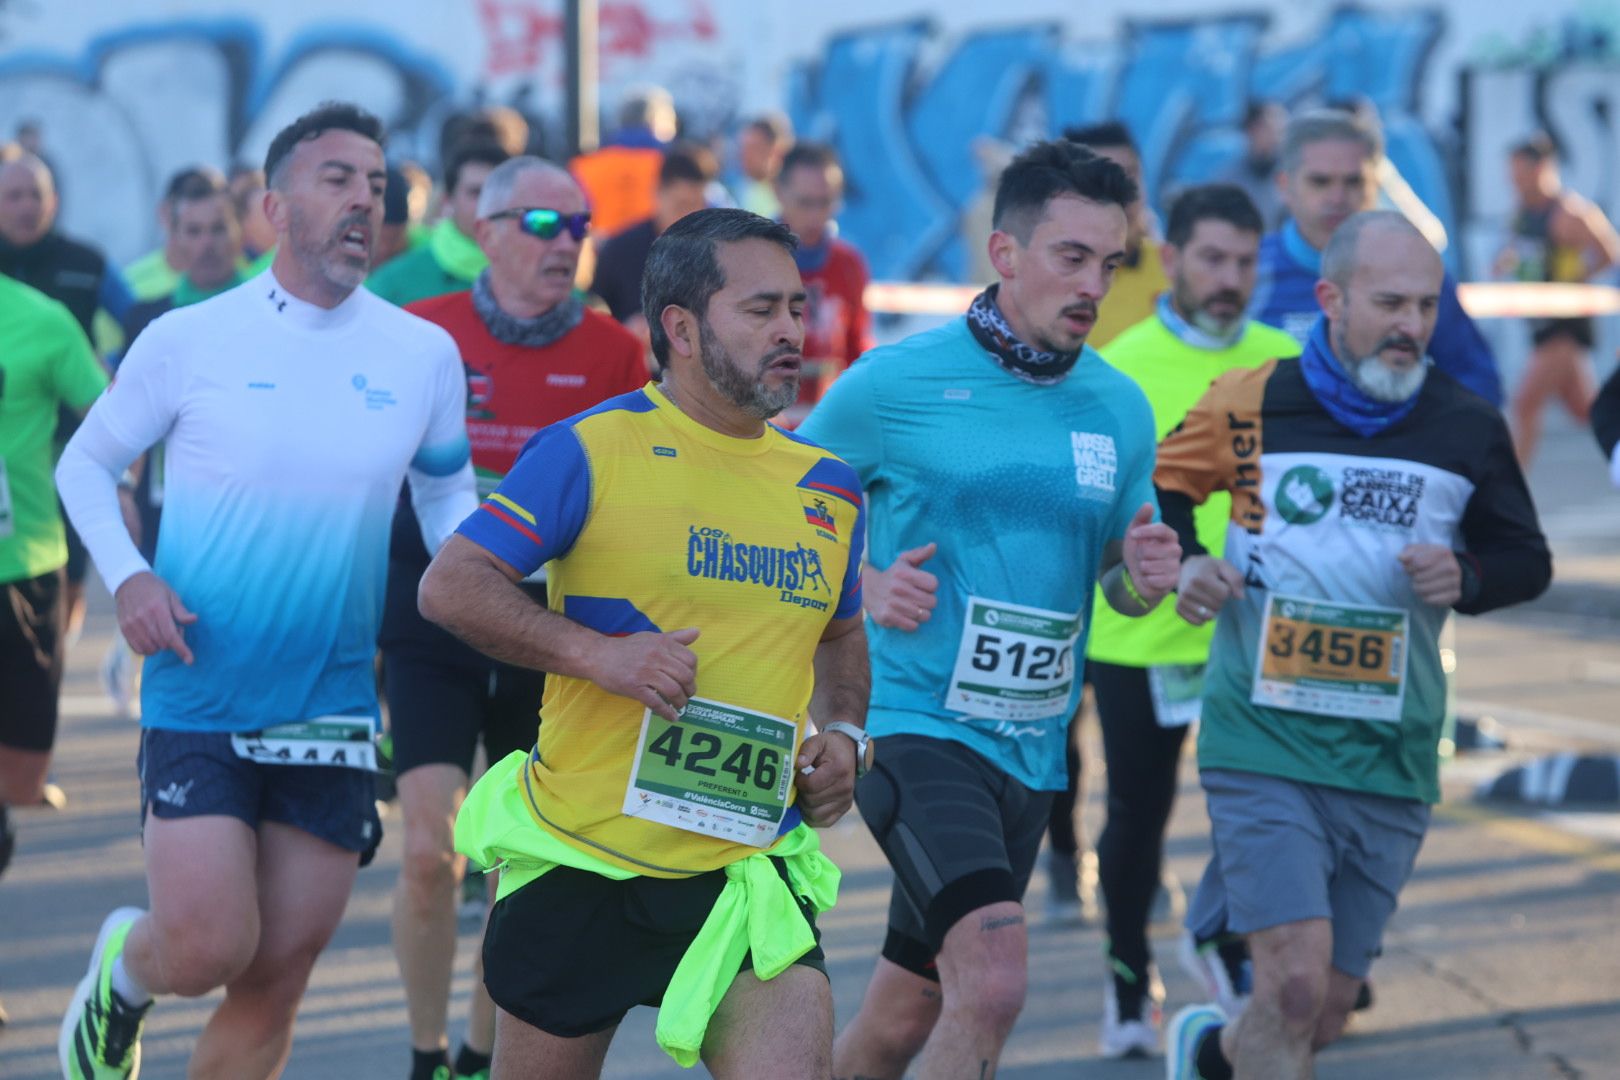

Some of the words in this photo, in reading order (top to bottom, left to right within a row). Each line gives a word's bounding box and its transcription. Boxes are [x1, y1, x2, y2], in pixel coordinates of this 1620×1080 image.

[1343, 467, 1403, 482] CIRCUIT
[1341, 487, 1418, 514] CAIXA
[689, 525, 723, 538] LOS
[687, 534, 800, 591] CHASQUIS
[1270, 622, 1385, 670] 3456
[649, 725, 779, 790] 4246
[697, 780, 742, 796] PREFERENT
[742, 790, 748, 798] D
[684, 791, 746, 813] #ValènciaCorre
